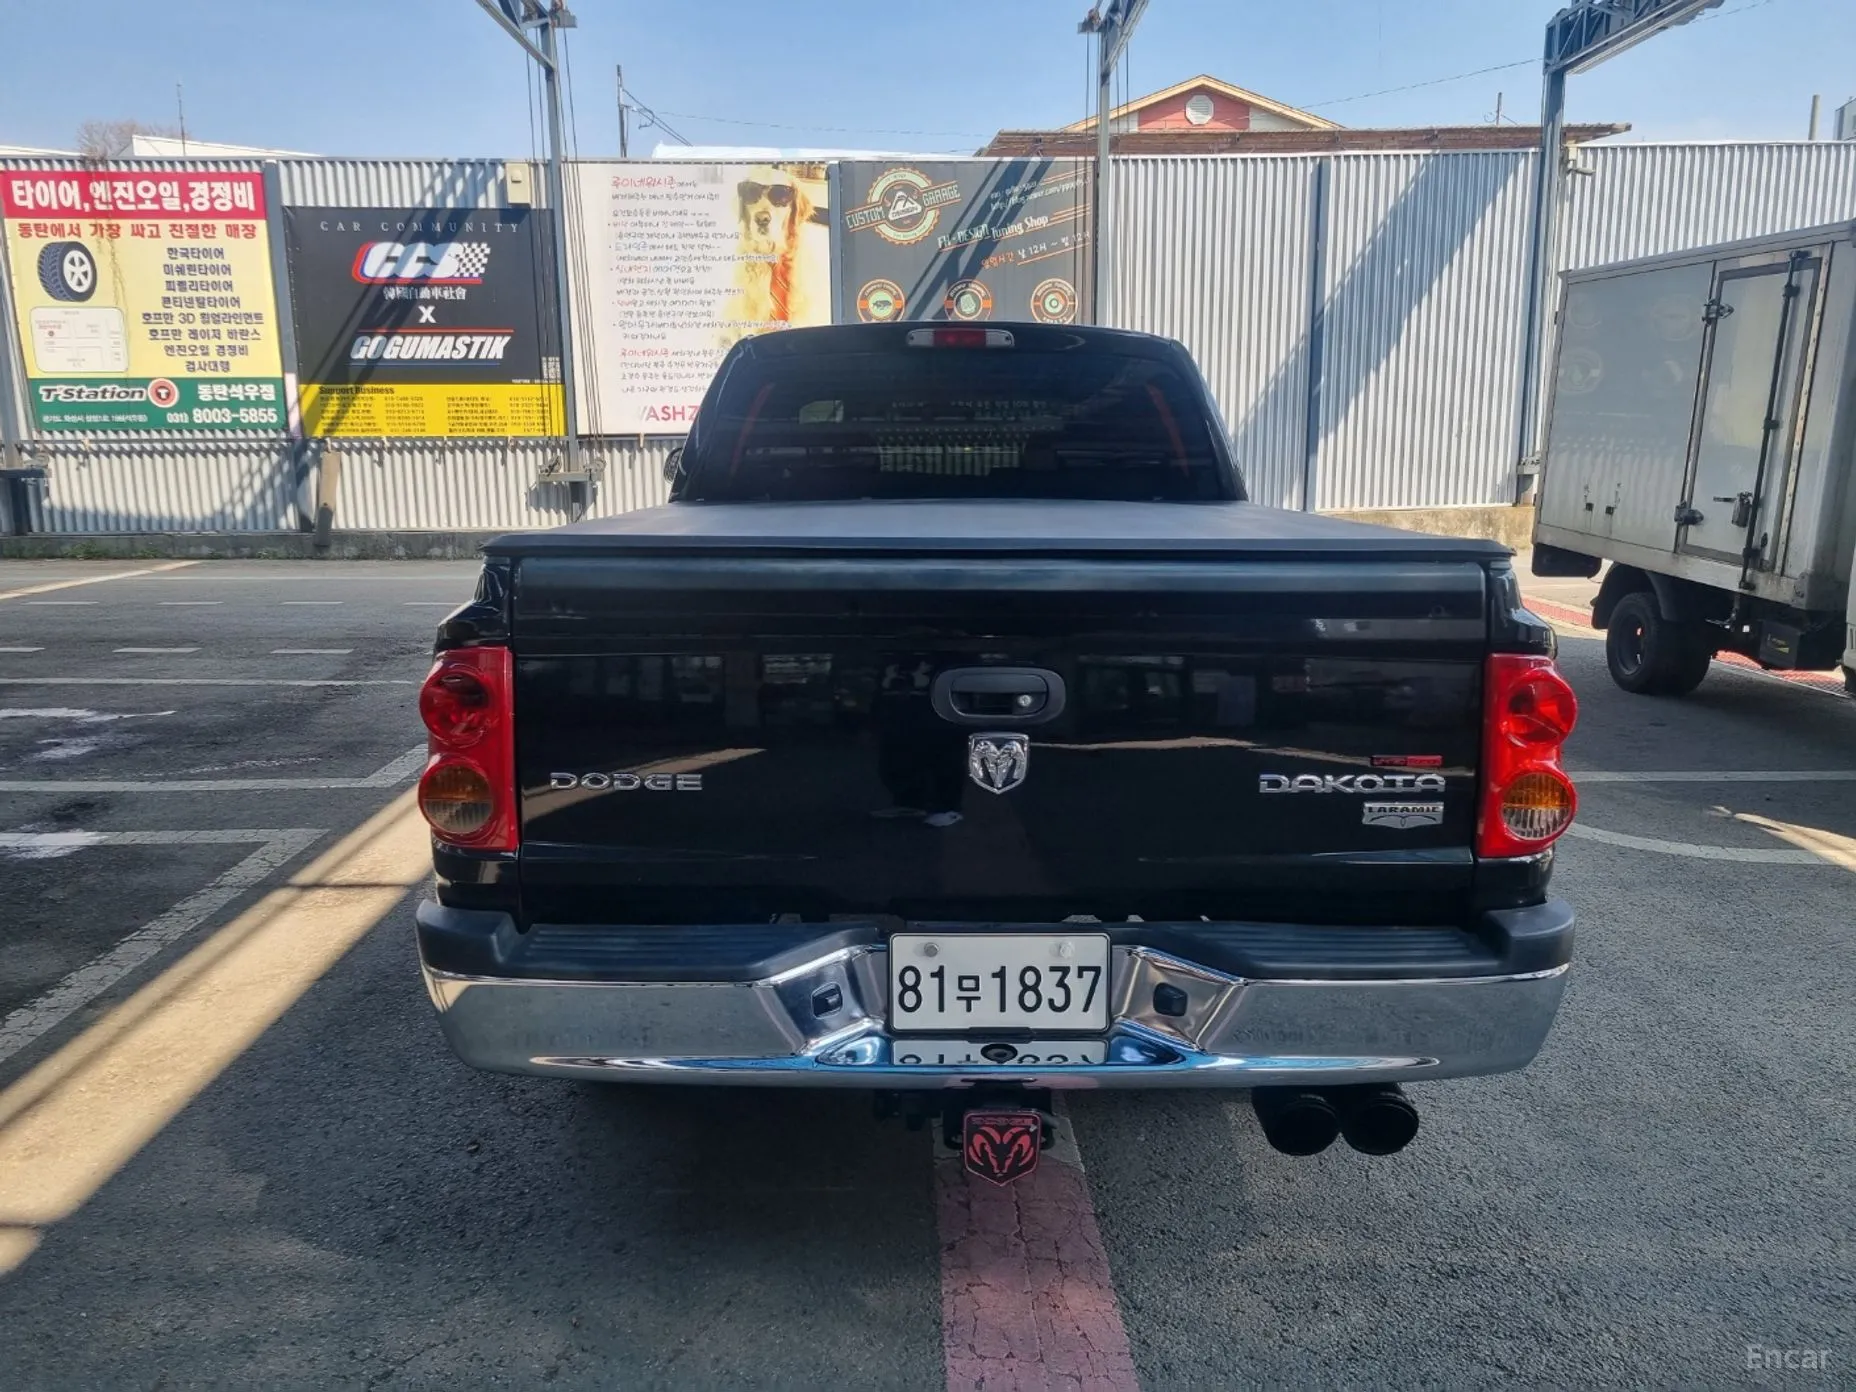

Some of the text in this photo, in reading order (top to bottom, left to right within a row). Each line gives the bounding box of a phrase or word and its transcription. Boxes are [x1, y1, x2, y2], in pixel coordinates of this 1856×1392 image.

[846, 206, 886, 229] CUSTOM
[922, 184, 961, 206] GARAGE
[320, 220, 519, 233] CAR COMMUNITY
[1024, 215, 1049, 230] Shop
[17, 223, 257, 239] 동탄에서 가장 싸고 친절한 매장
[167, 247, 224, 260] 한국타이어
[163, 263, 232, 276] 미쉐린타이어
[142, 312, 174, 325] 호프만
[178, 313, 195, 325] 3D
[149, 328, 182, 341] 호프만
[164, 344, 249, 356] 엔진오일 경정비
[351, 335, 511, 360] GOGUMASTIK
[185, 360, 230, 373] 검사대행
[198, 384, 276, 401] 동탄석우점
[355, 386, 395, 395] Business
[192, 407, 278, 424] 8003-5855
[550, 772, 703, 791] DODGE
[1259, 773, 1446, 794] DAKOTA
[1367, 805, 1441, 814] LARAMIE
